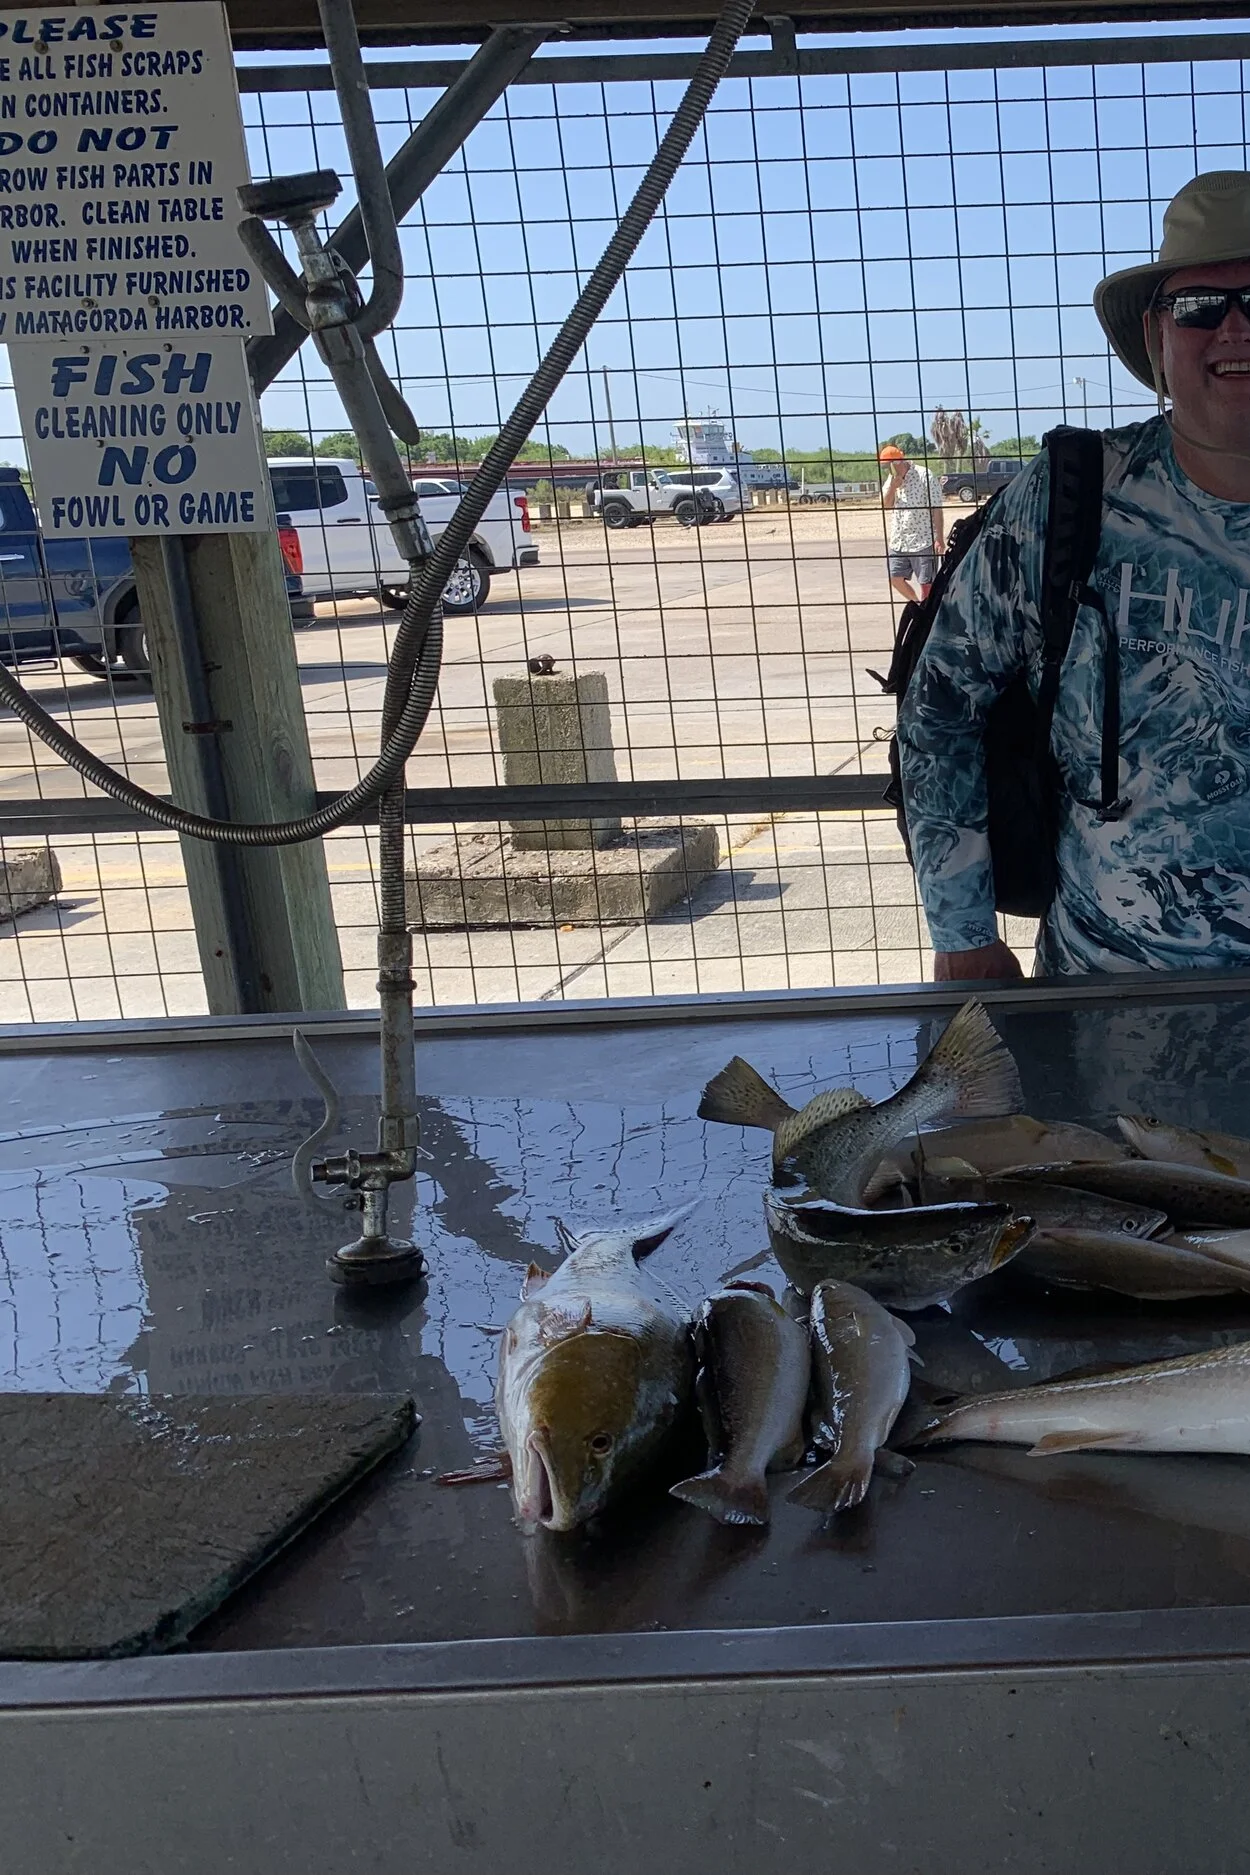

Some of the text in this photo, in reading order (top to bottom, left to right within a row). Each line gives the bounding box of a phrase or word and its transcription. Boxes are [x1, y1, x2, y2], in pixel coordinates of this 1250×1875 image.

[19, 55, 56, 81] ALL
[64, 52, 112, 79] FISH
[121, 50, 203, 77] SCRAPS
[25, 88, 168, 118] CONTAINERS.
[0, 125, 179, 156] DO NOT
[56, 164, 104, 190] FISH
[113, 162, 180, 188] PARTS
[188, 160, 213, 185] IN
[82, 200, 149, 226] CLEAN
[158, 197, 223, 223] TABLE
[11, 234, 196, 264] WHEN FINISHED.
[24, 272, 118, 299] FACILITY
[125, 268, 250, 296] FURNISHED
[15, 307, 148, 335] MATAGORDA
[156, 304, 251, 331] HARBOR.
[51, 352, 212, 397] FISH
[34, 401, 241, 440] CLEANING ONLY
[97, 444, 197, 486] NO
[51, 491, 254, 529] FOWL OR GAME
[1118, 636, 1218, 664] PERFORMANCE
[1206, 785, 1231, 801] MOSSY
